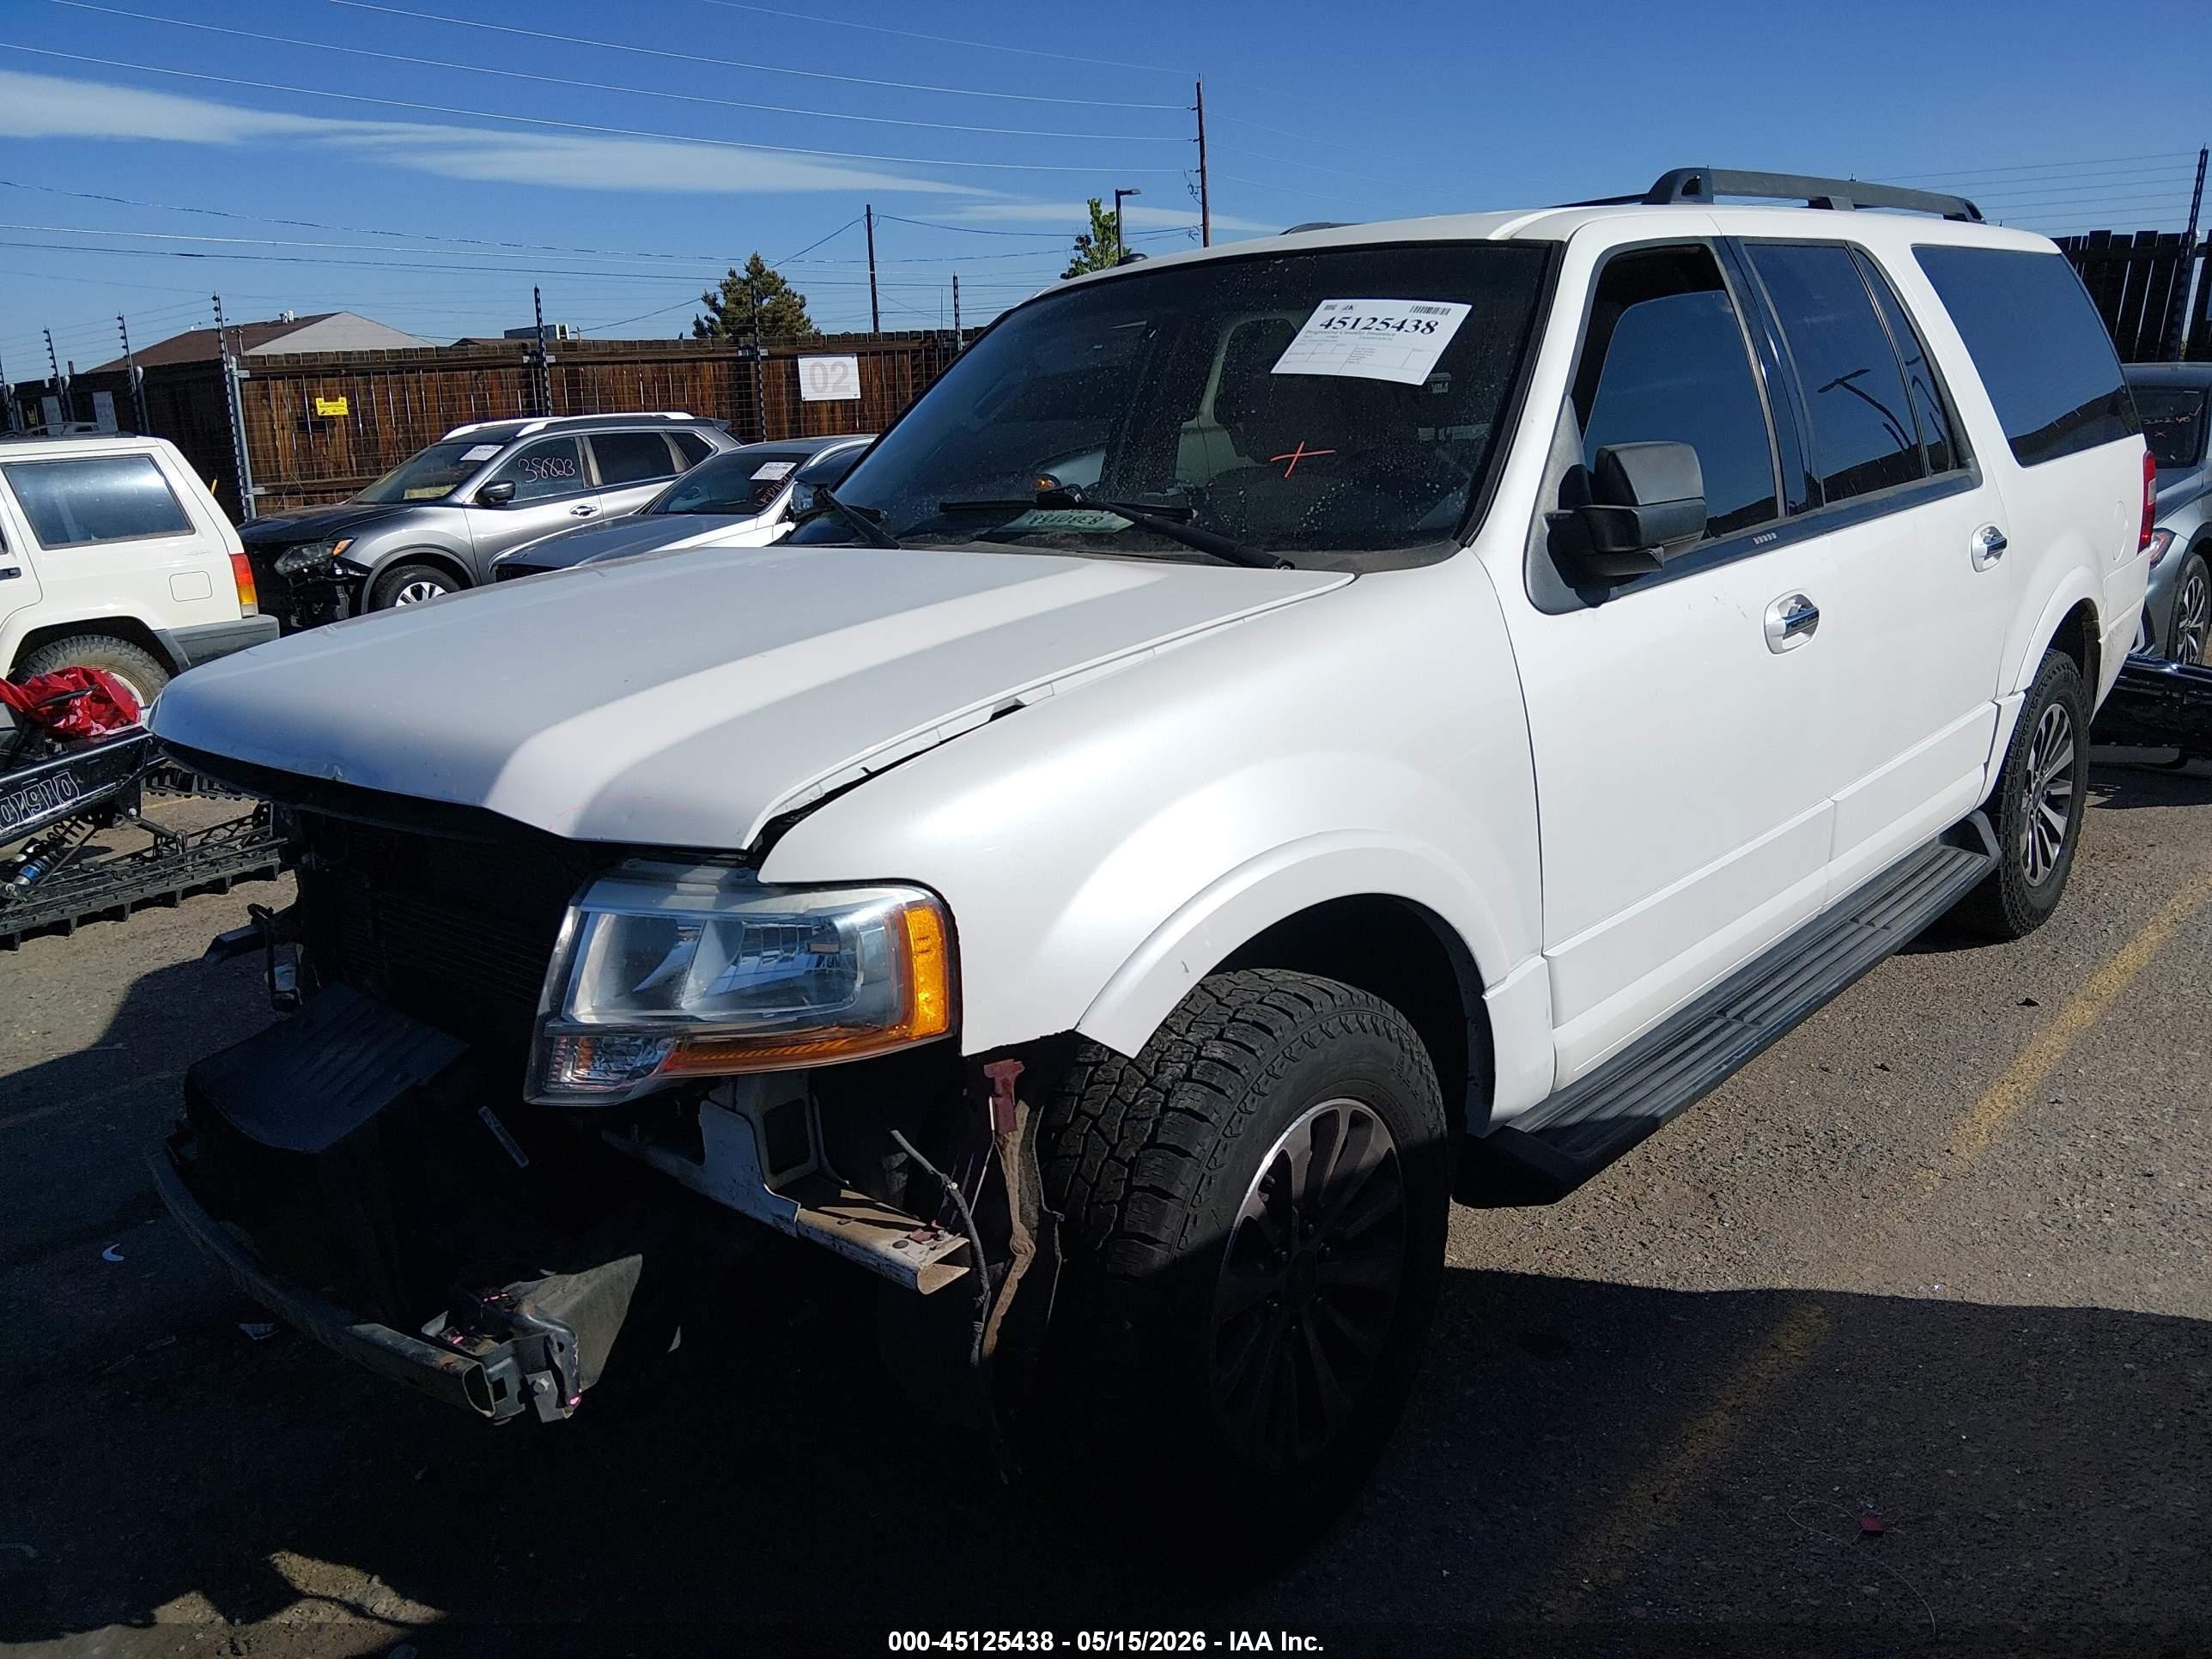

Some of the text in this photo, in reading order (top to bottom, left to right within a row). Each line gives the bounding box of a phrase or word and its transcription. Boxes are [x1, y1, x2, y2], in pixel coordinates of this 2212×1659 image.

[1319, 315, 1439, 335] 45125438
[810, 361, 850, 392] 02
[518, 457, 576, 483] 38823
